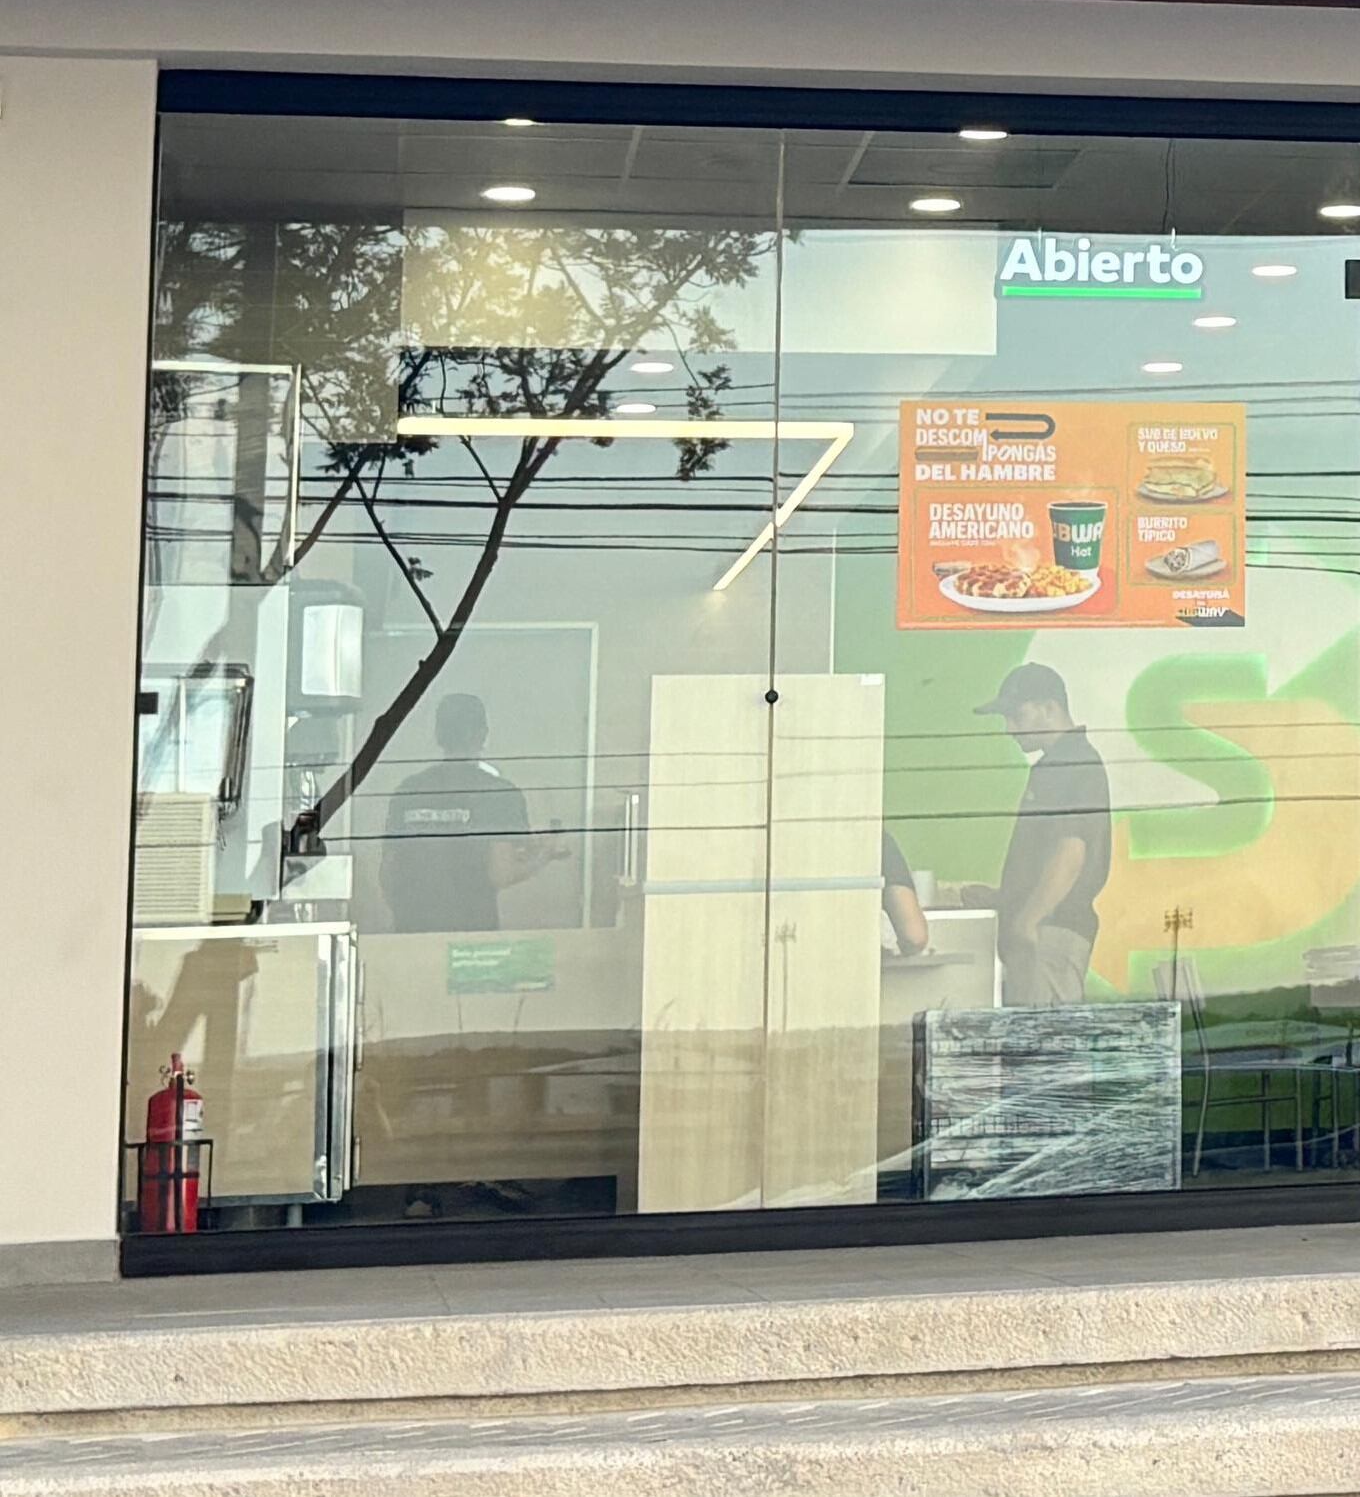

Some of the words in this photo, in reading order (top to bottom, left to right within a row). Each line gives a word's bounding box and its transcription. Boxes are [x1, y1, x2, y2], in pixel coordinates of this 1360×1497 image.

[1000, 238, 1203, 284] Abierto
[916, 408, 950, 425] NO
[952, 409, 980, 425] TE
[1138, 441, 1146, 452] Y
[915, 464, 957, 480] DEL
[960, 464, 1057, 481] HAMBRE
[929, 503, 1025, 521] DESAYUNO
[929, 521, 1035, 539] AMERICANO
[1137, 517, 1188, 529] BURRITO
